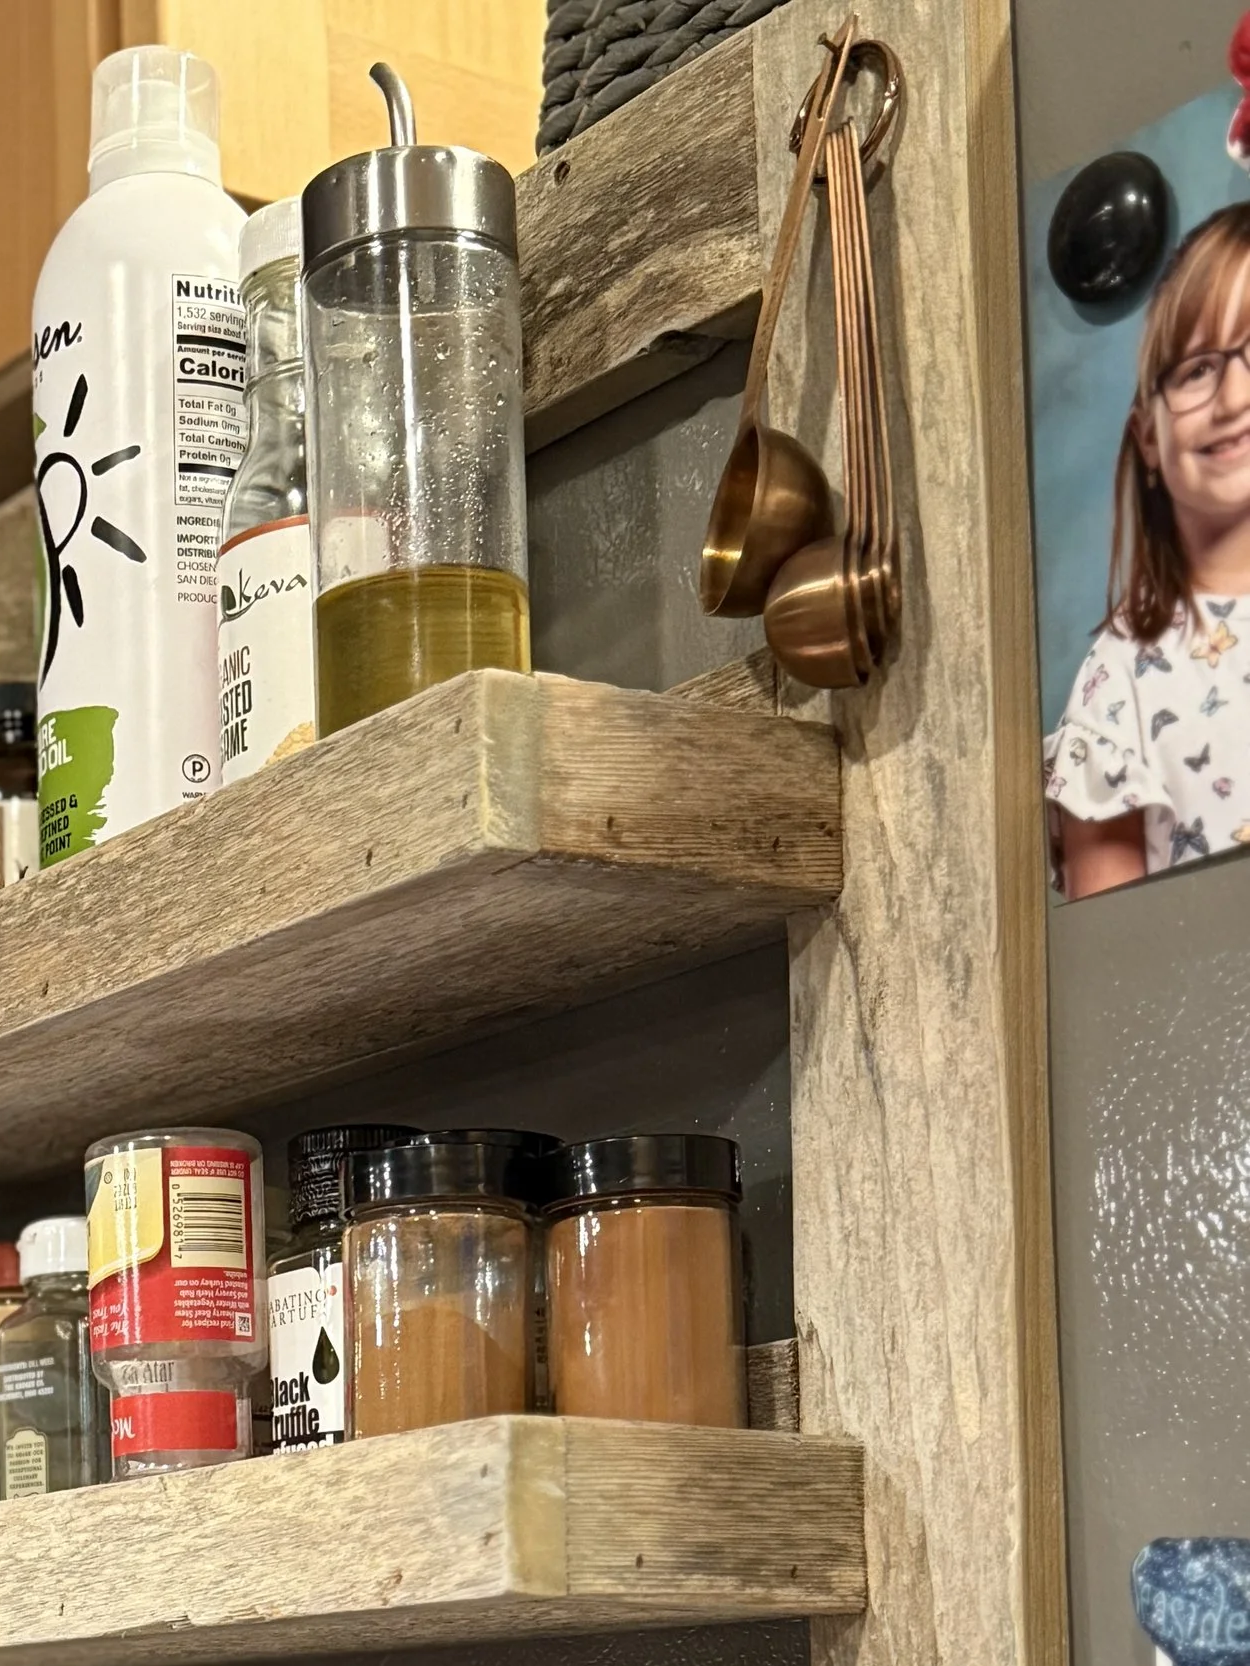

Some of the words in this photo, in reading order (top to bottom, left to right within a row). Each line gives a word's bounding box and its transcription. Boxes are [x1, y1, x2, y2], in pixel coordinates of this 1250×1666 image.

[177, 321, 206, 334] Serving
[179, 357, 244, 384] Calori
[178, 399, 204, 410] Total
[208, 402, 223, 412] Fat
[225, 405, 237, 417] 0g
[179, 416, 219, 428] Sodium
[179, 433, 205, 444] Total
[179, 450, 217, 463] Protein
[220, 453, 231, 466] 0g
[177, 562, 216, 572] CHOSEN
[48, 738, 73, 770] OIL
[200, 1278, 224, 1288] Turkey
[215, 1288, 237, 1299] Savory
[174, 1298, 215, 1308] Vegetables
[212, 1308, 234, 1318] Hearty
[194, 1318, 219, 1328] recipes
